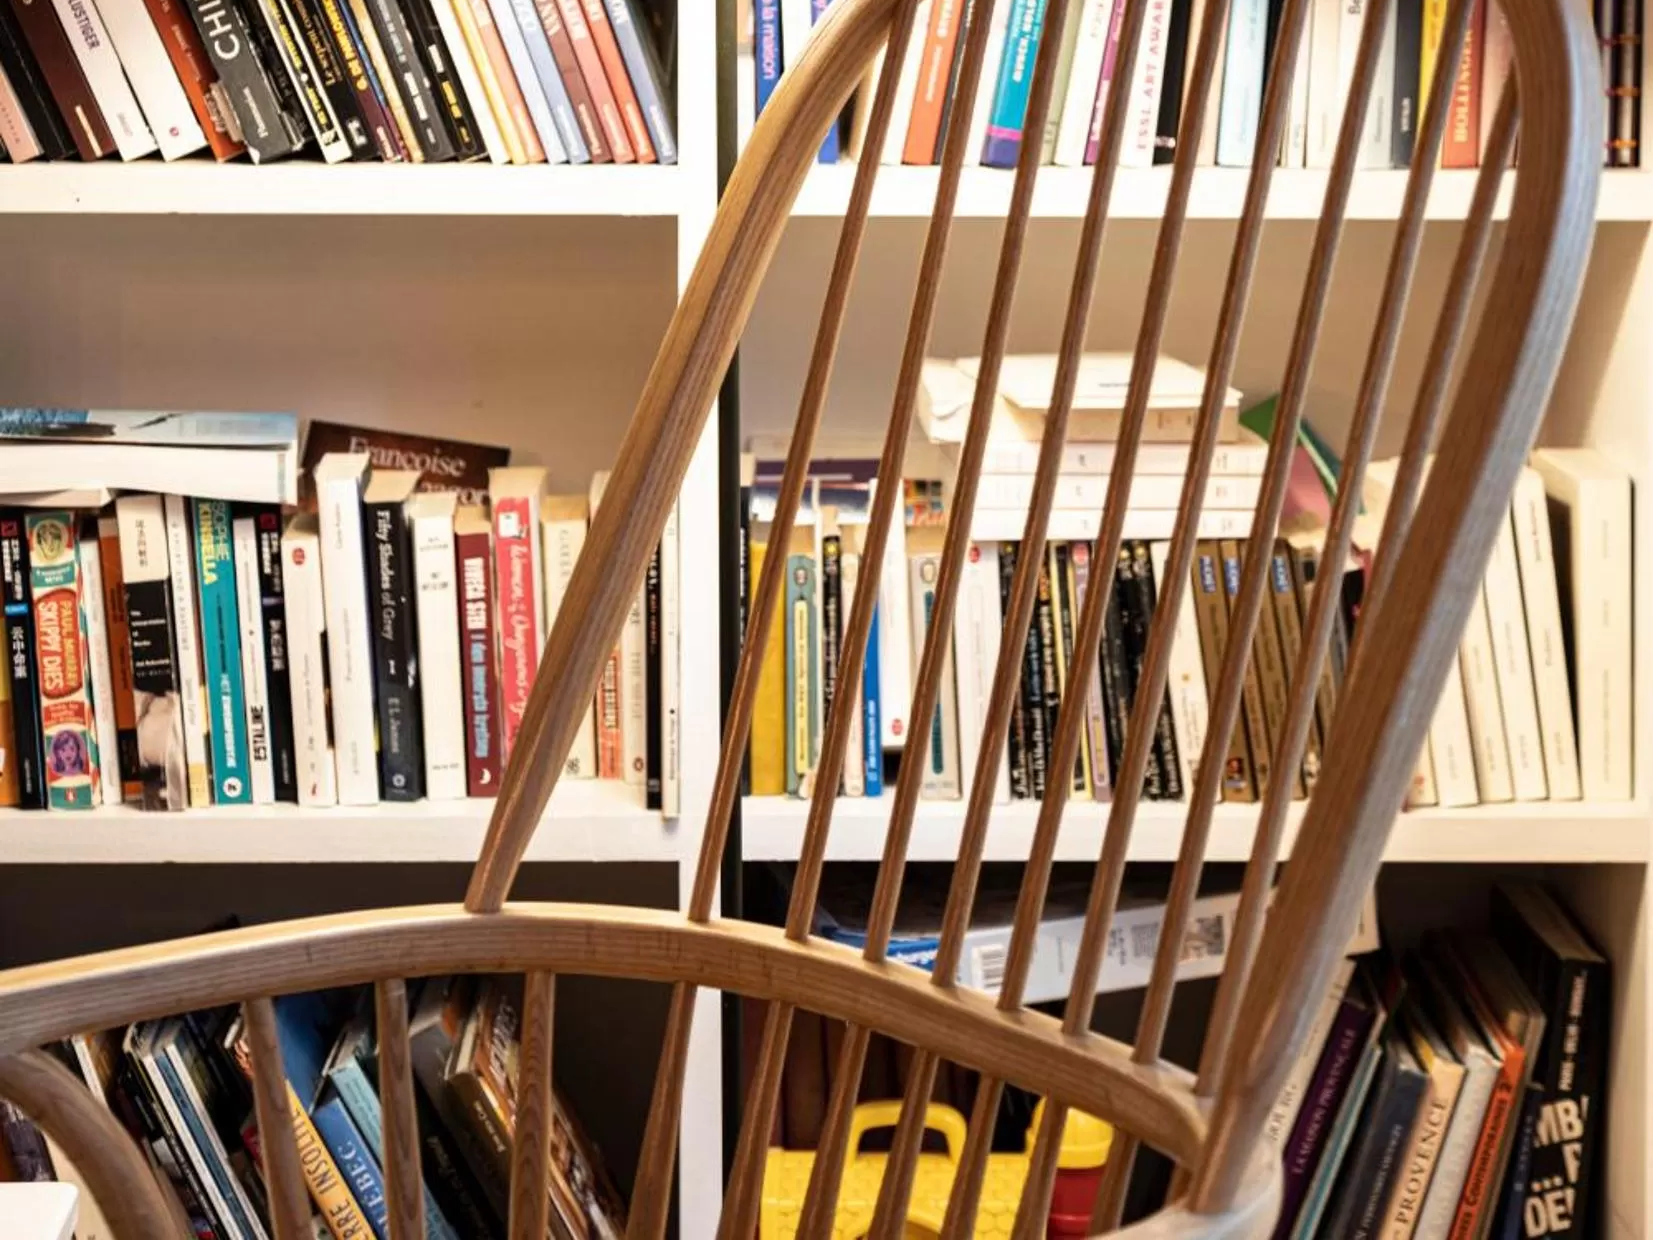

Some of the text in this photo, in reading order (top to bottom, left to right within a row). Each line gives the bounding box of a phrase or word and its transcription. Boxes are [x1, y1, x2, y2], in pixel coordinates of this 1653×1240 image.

[538, 0, 564, 36] VAN
[763, 7, 777, 20] la
[304, 27, 332, 70] serpent
[762, 24, 776, 79] maison
[319, 69, 336, 86] Le
[1142, 62, 1157, 97] ART
[1452, 28, 1475, 143] BOLLINGER
[376, 510, 395, 641] Fifty Shades of Grey
[510, 544, 529, 600] Women
[59, 600, 74, 635] PAUL
[37, 601, 63, 691] SKIPPY DIES
[388, 718, 401, 753] James
[1297, 1106, 1326, 1156] MAISON
[1392, 1095, 1450, 1226] PROVENCE
